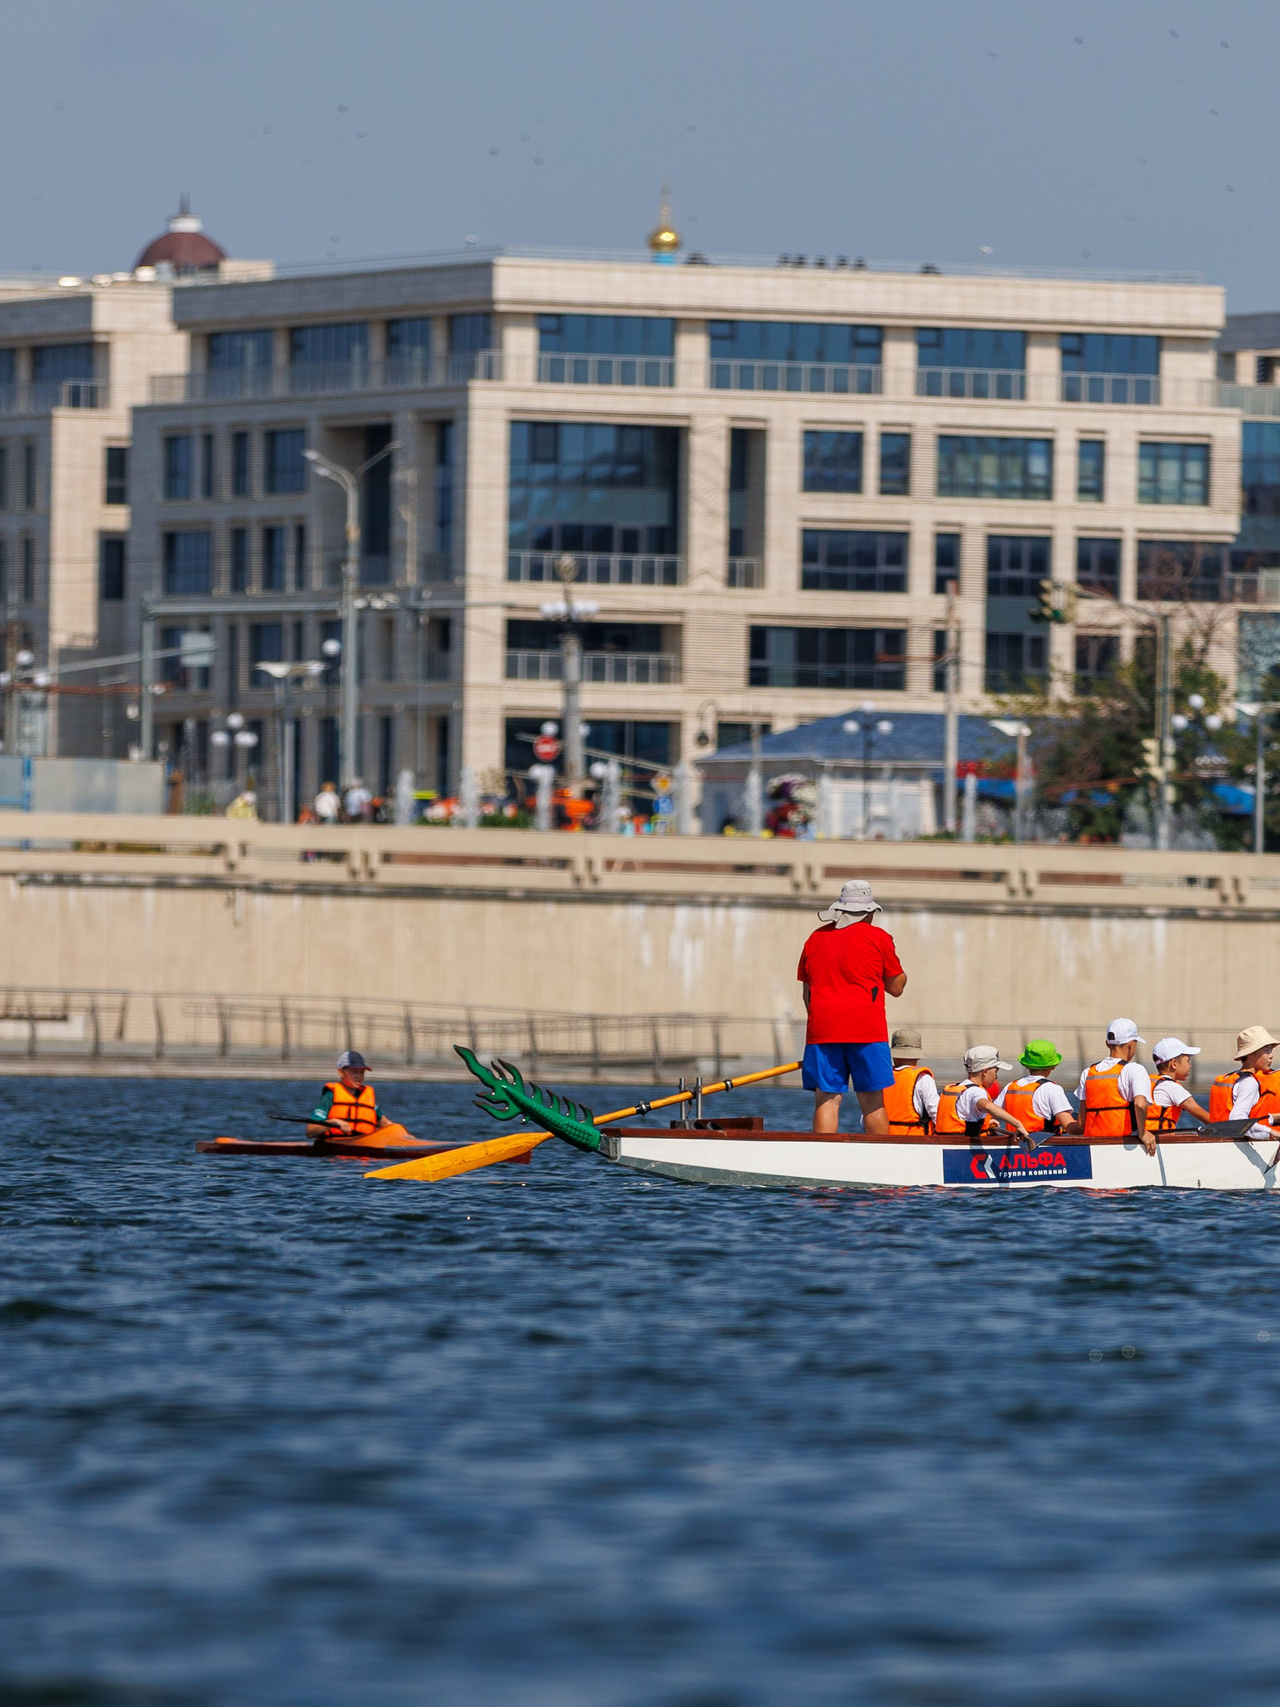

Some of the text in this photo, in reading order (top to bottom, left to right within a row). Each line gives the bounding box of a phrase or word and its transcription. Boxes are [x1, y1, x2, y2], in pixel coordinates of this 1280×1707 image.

[1000, 1151, 1067, 1169] АЛЬФА
[999, 1168, 1067, 1178] группа компаний
